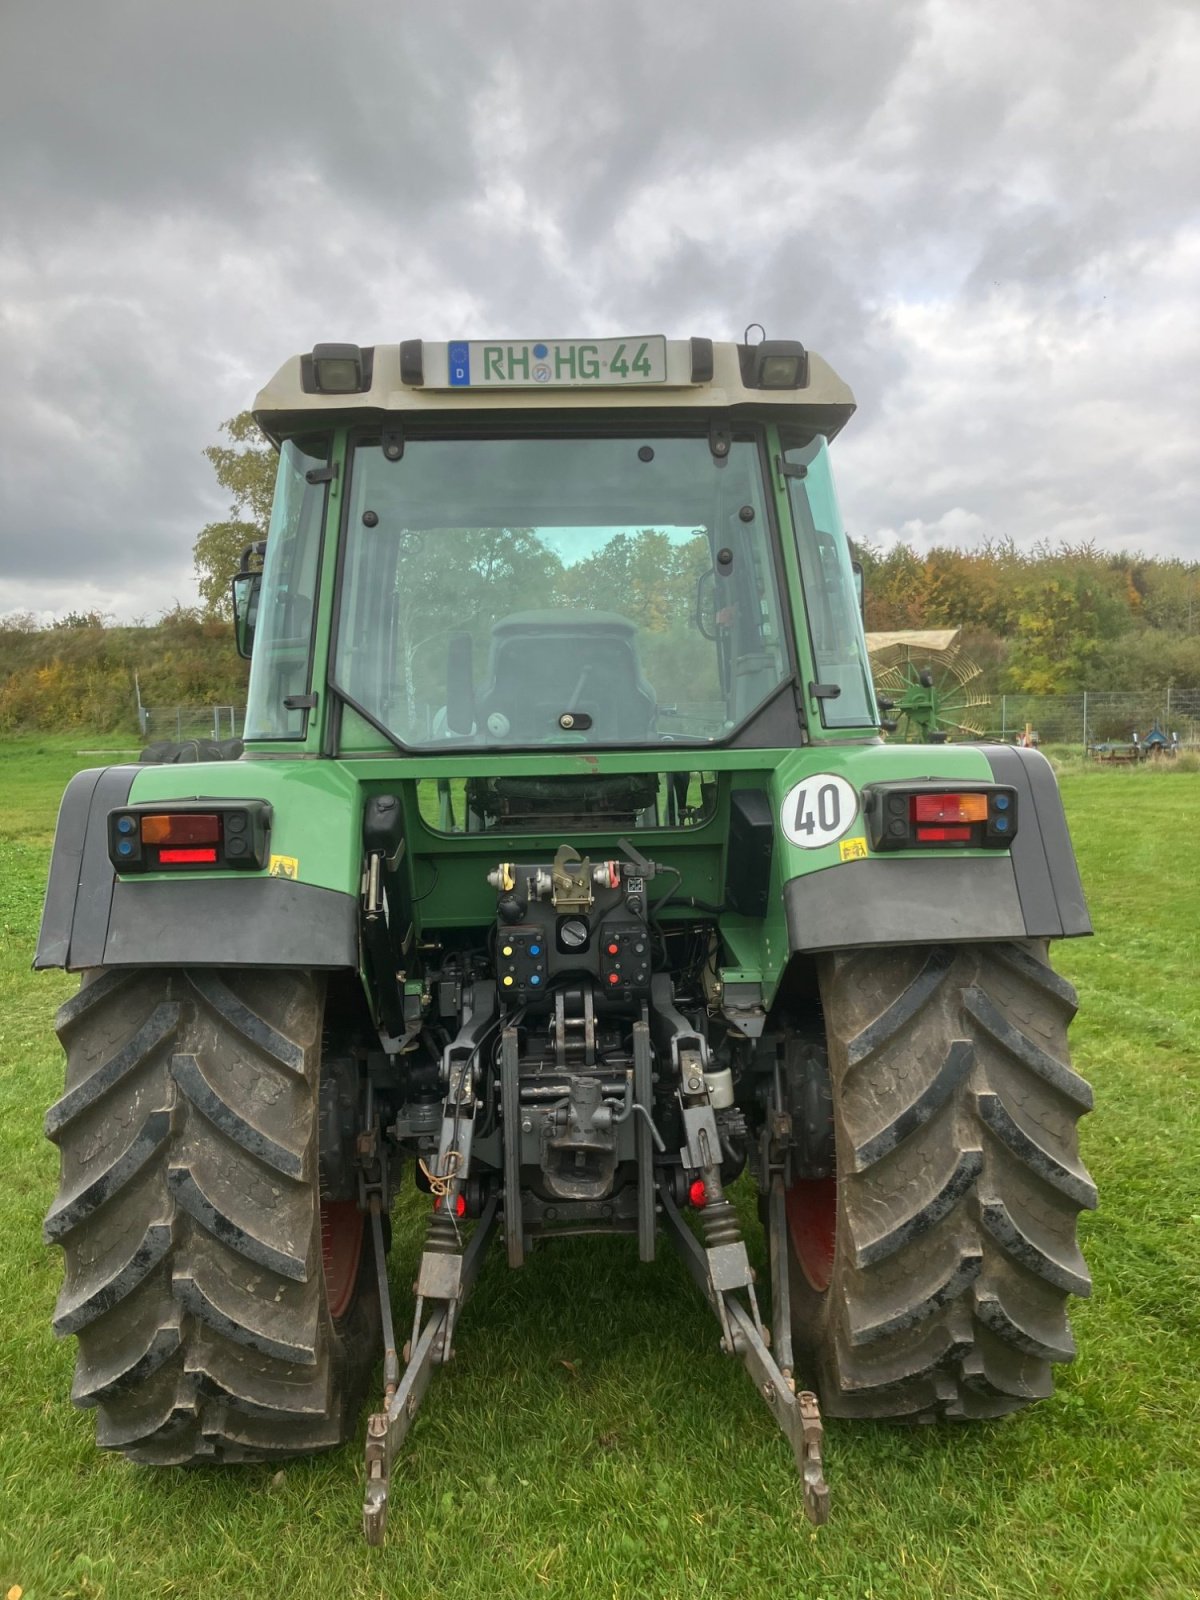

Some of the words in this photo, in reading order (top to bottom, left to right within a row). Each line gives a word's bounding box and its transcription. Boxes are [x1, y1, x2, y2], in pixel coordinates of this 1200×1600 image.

[456, 368, 464, 379] D
[483, 346, 529, 381] RH
[554, 345, 600, 380] HG
[609, 342, 652, 378] 44
[794, 783, 841, 836] 40
